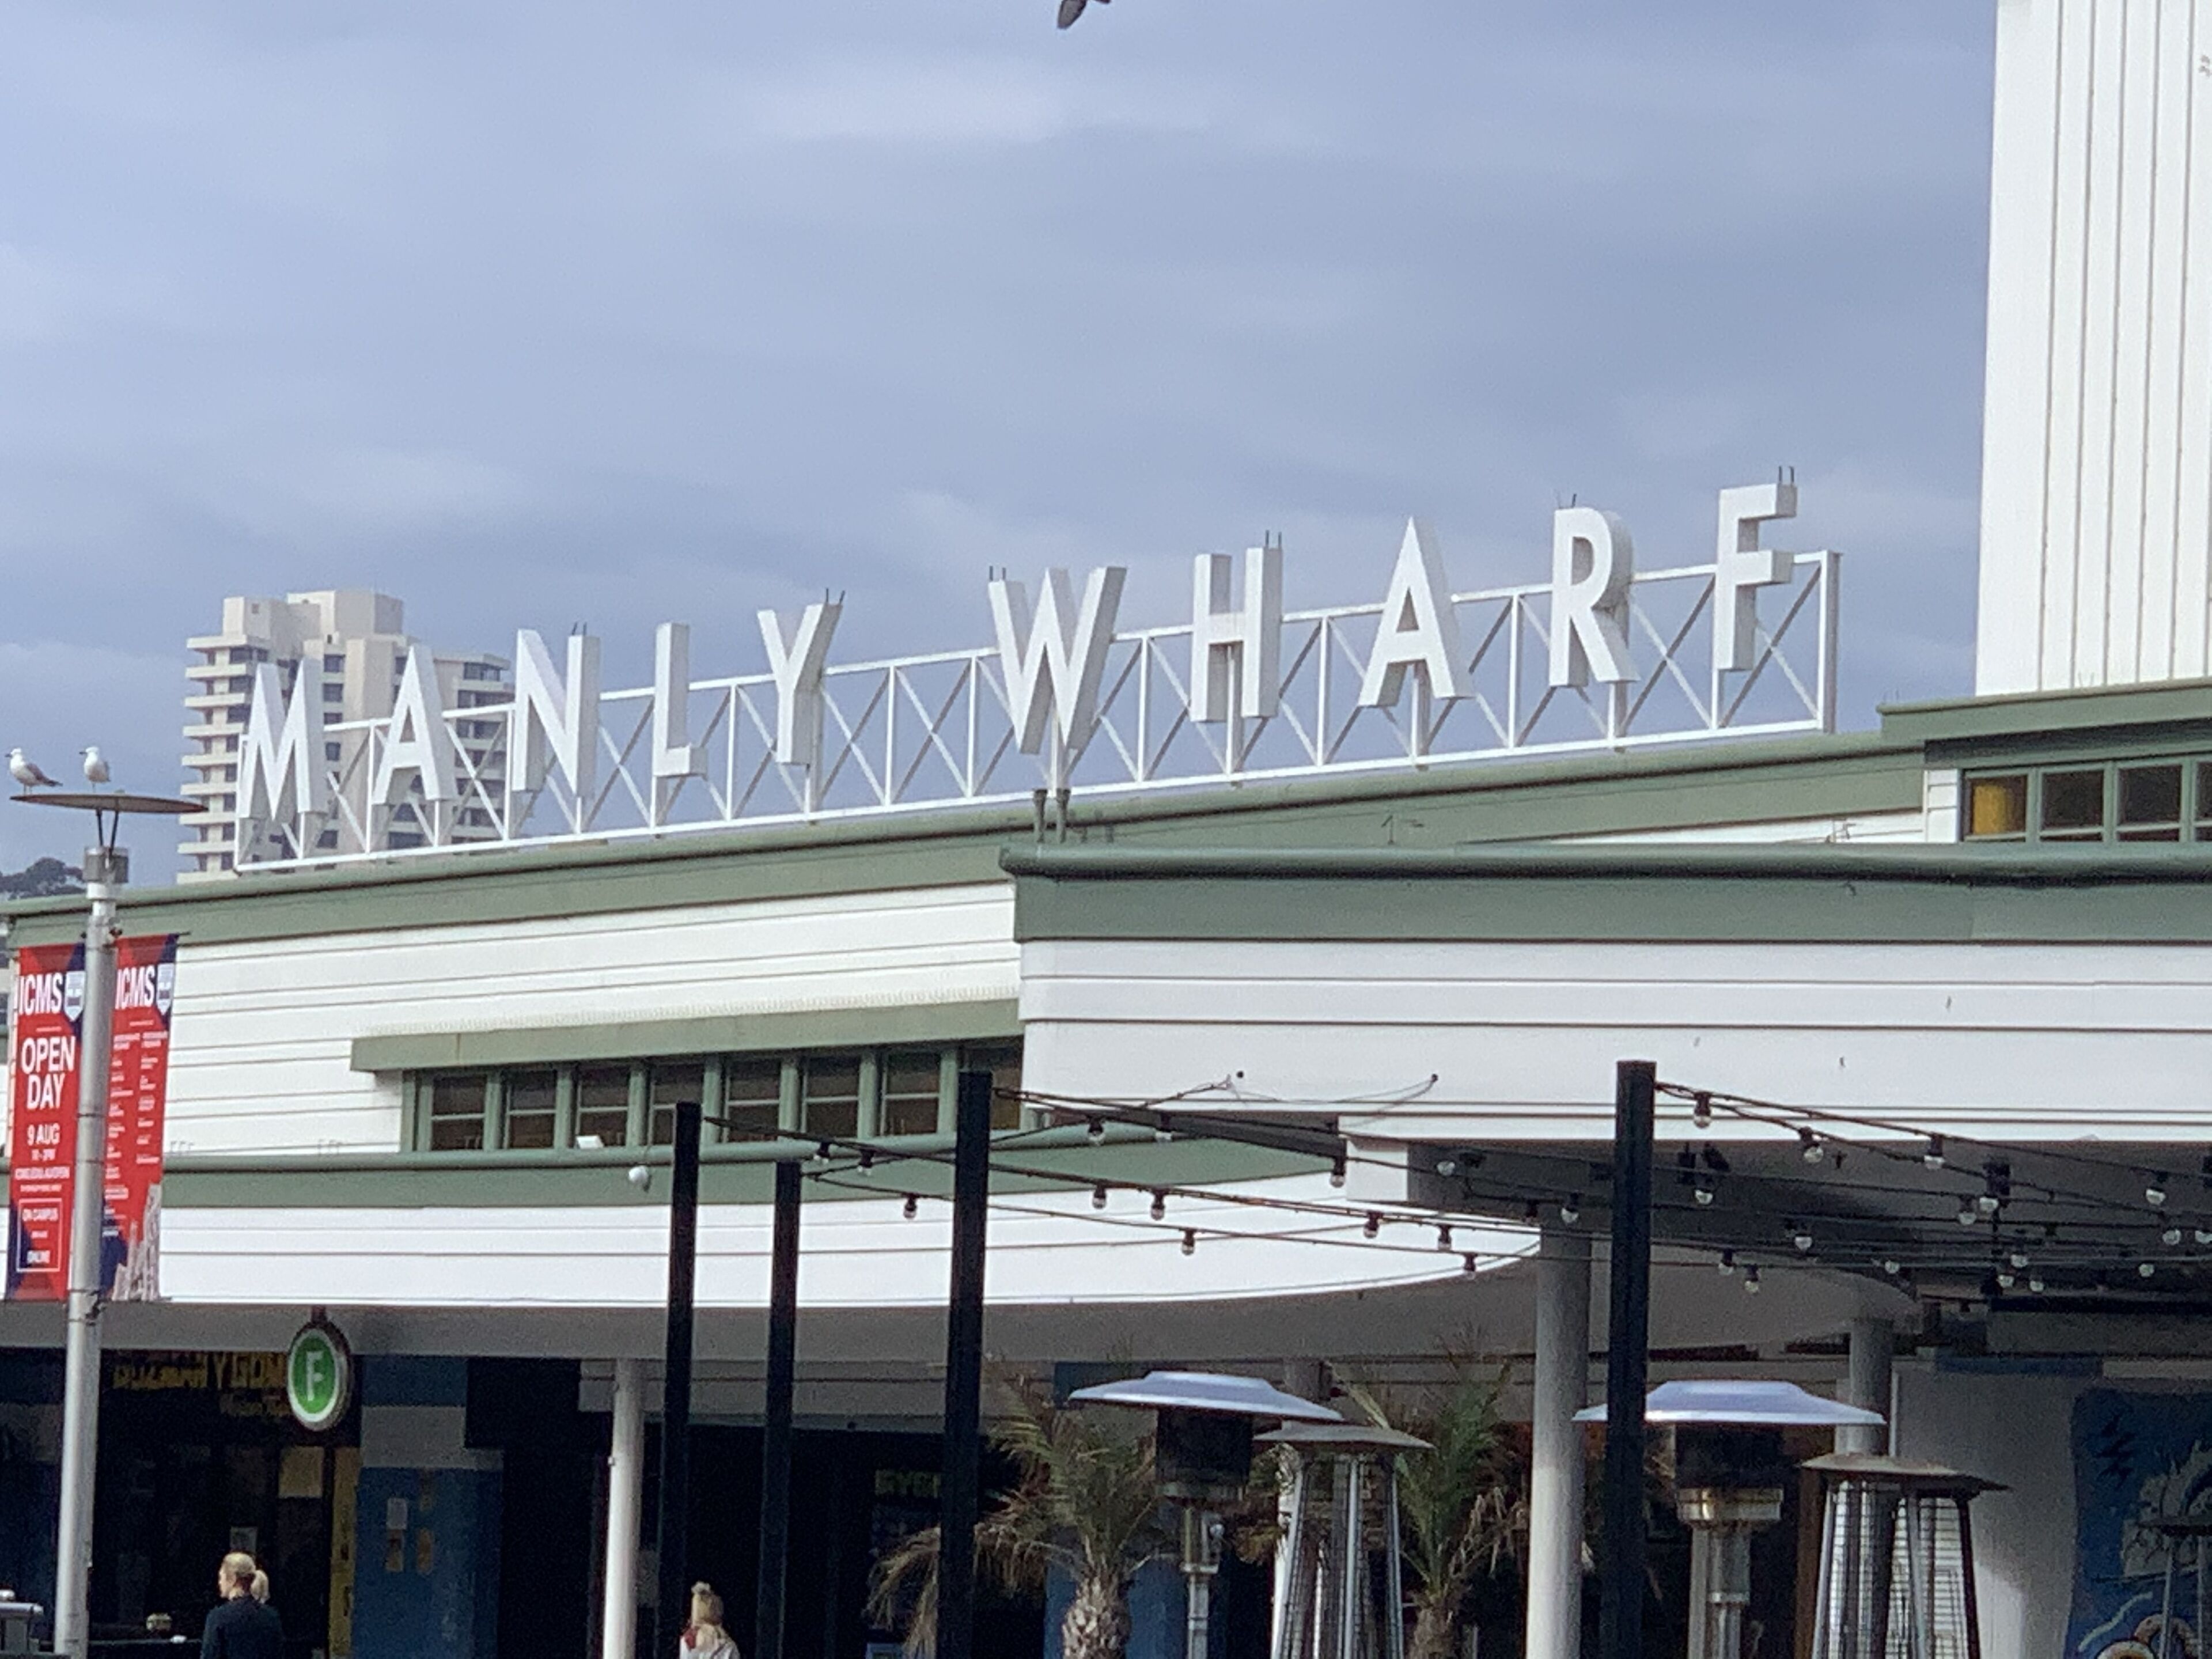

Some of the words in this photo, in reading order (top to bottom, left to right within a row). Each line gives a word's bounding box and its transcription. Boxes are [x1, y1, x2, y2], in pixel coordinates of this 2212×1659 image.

[235, 603, 842, 820] MANLY
[988, 483, 1795, 753] WHARF
[18, 972, 63, 1015] ICMS
[115, 965, 156, 1009] ICMS
[21, 1036, 75, 1074] OPEN
[26, 1073, 65, 1111] DAY
[27, 1124, 35, 1146] 9
[36, 1123, 60, 1145] AUG
[306, 1350, 324, 1402] F
